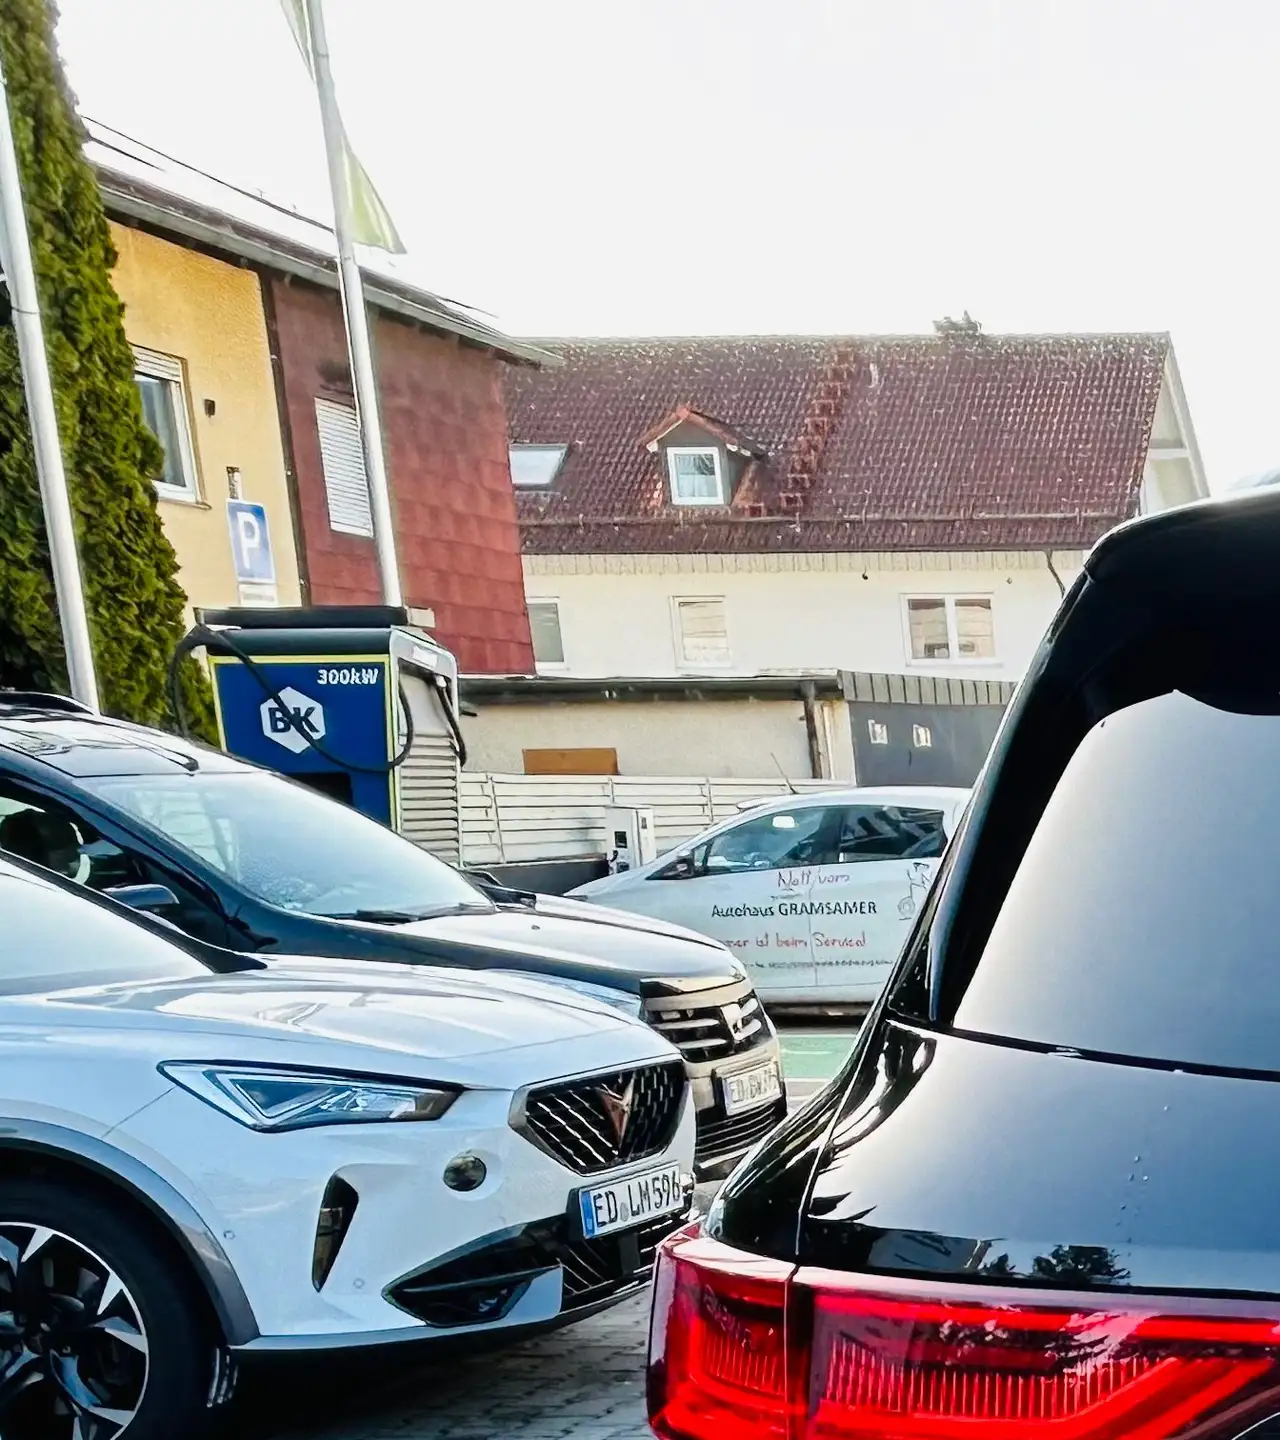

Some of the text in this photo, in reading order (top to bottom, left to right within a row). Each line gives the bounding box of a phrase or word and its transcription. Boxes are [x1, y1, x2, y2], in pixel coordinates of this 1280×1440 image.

[236, 511, 260, 569] P
[316, 668, 379, 686] 300kW
[711, 900, 877, 918] Autohaus GRAMSAMER
[593, 1190, 618, 1227] ED
